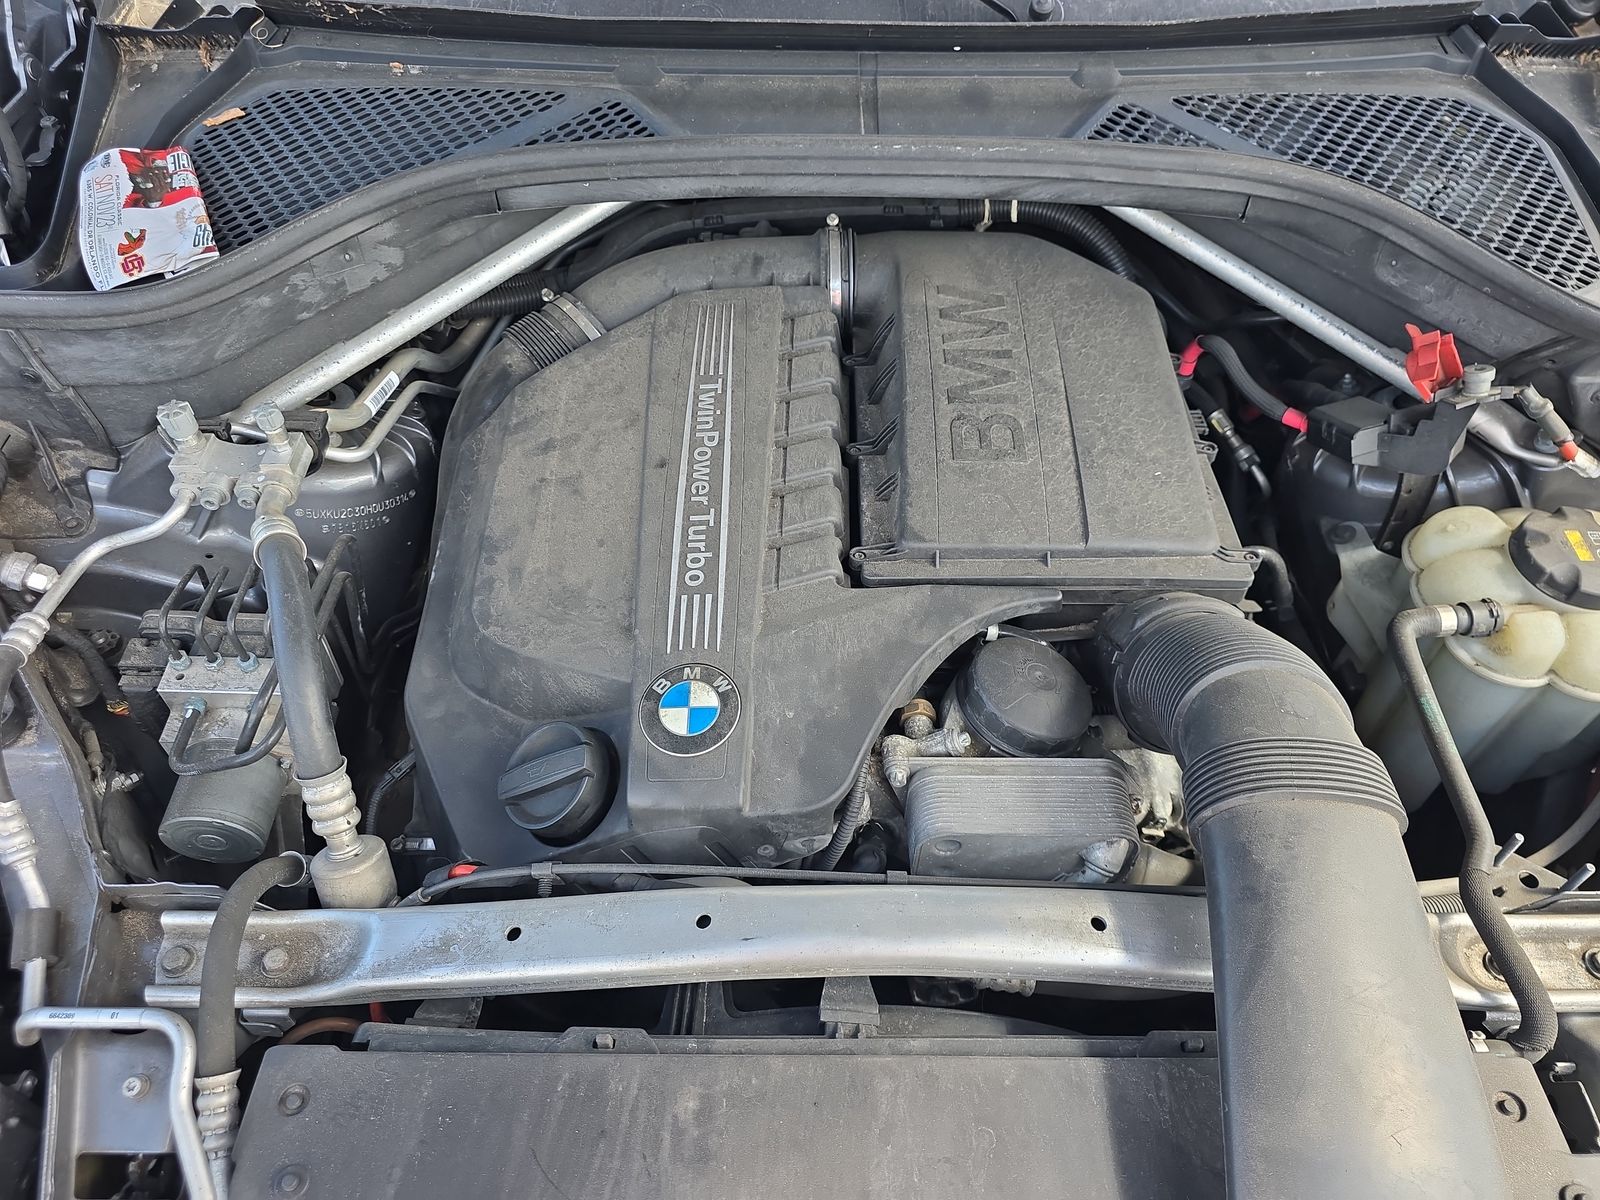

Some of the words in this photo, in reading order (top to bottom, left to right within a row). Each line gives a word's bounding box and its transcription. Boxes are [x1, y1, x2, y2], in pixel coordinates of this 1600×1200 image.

[95, 174, 113, 194] SAT
[96, 194, 115, 215] NOV
[87, 230, 94, 239] DR
[96, 215, 115, 227] 23
[88, 240, 101, 278] ORLANDO
[936, 285, 1028, 462] BMW
[690, 378, 722, 505] TwinPower
[684, 508, 715, 587] Turbo
[651, 667, 732, 695] BMW
